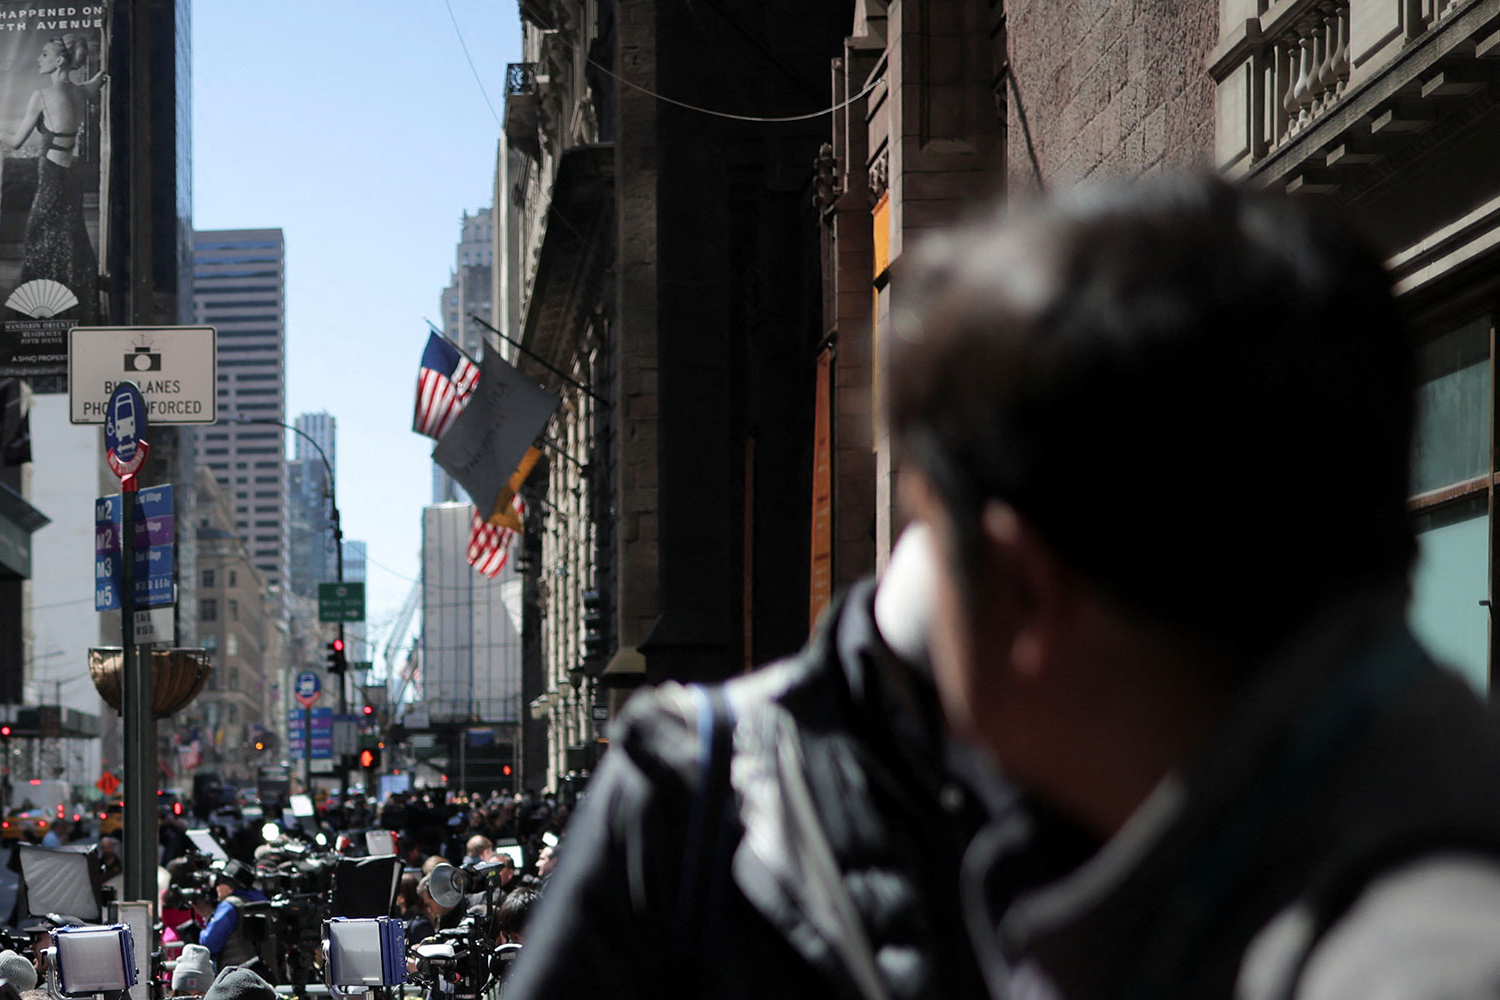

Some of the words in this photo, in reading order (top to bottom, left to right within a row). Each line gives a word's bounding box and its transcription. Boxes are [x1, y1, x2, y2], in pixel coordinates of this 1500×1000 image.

[83, 6, 103, 15] ON
[37, 19, 103, 30] AVENUE
[138, 381, 180, 394] LANES
[84, 402, 108, 415] PHO
[97, 500, 112, 521] M2
[97, 529, 112, 550] M2
[97, 557, 112, 578] M3
[97, 585, 112, 607] M5
